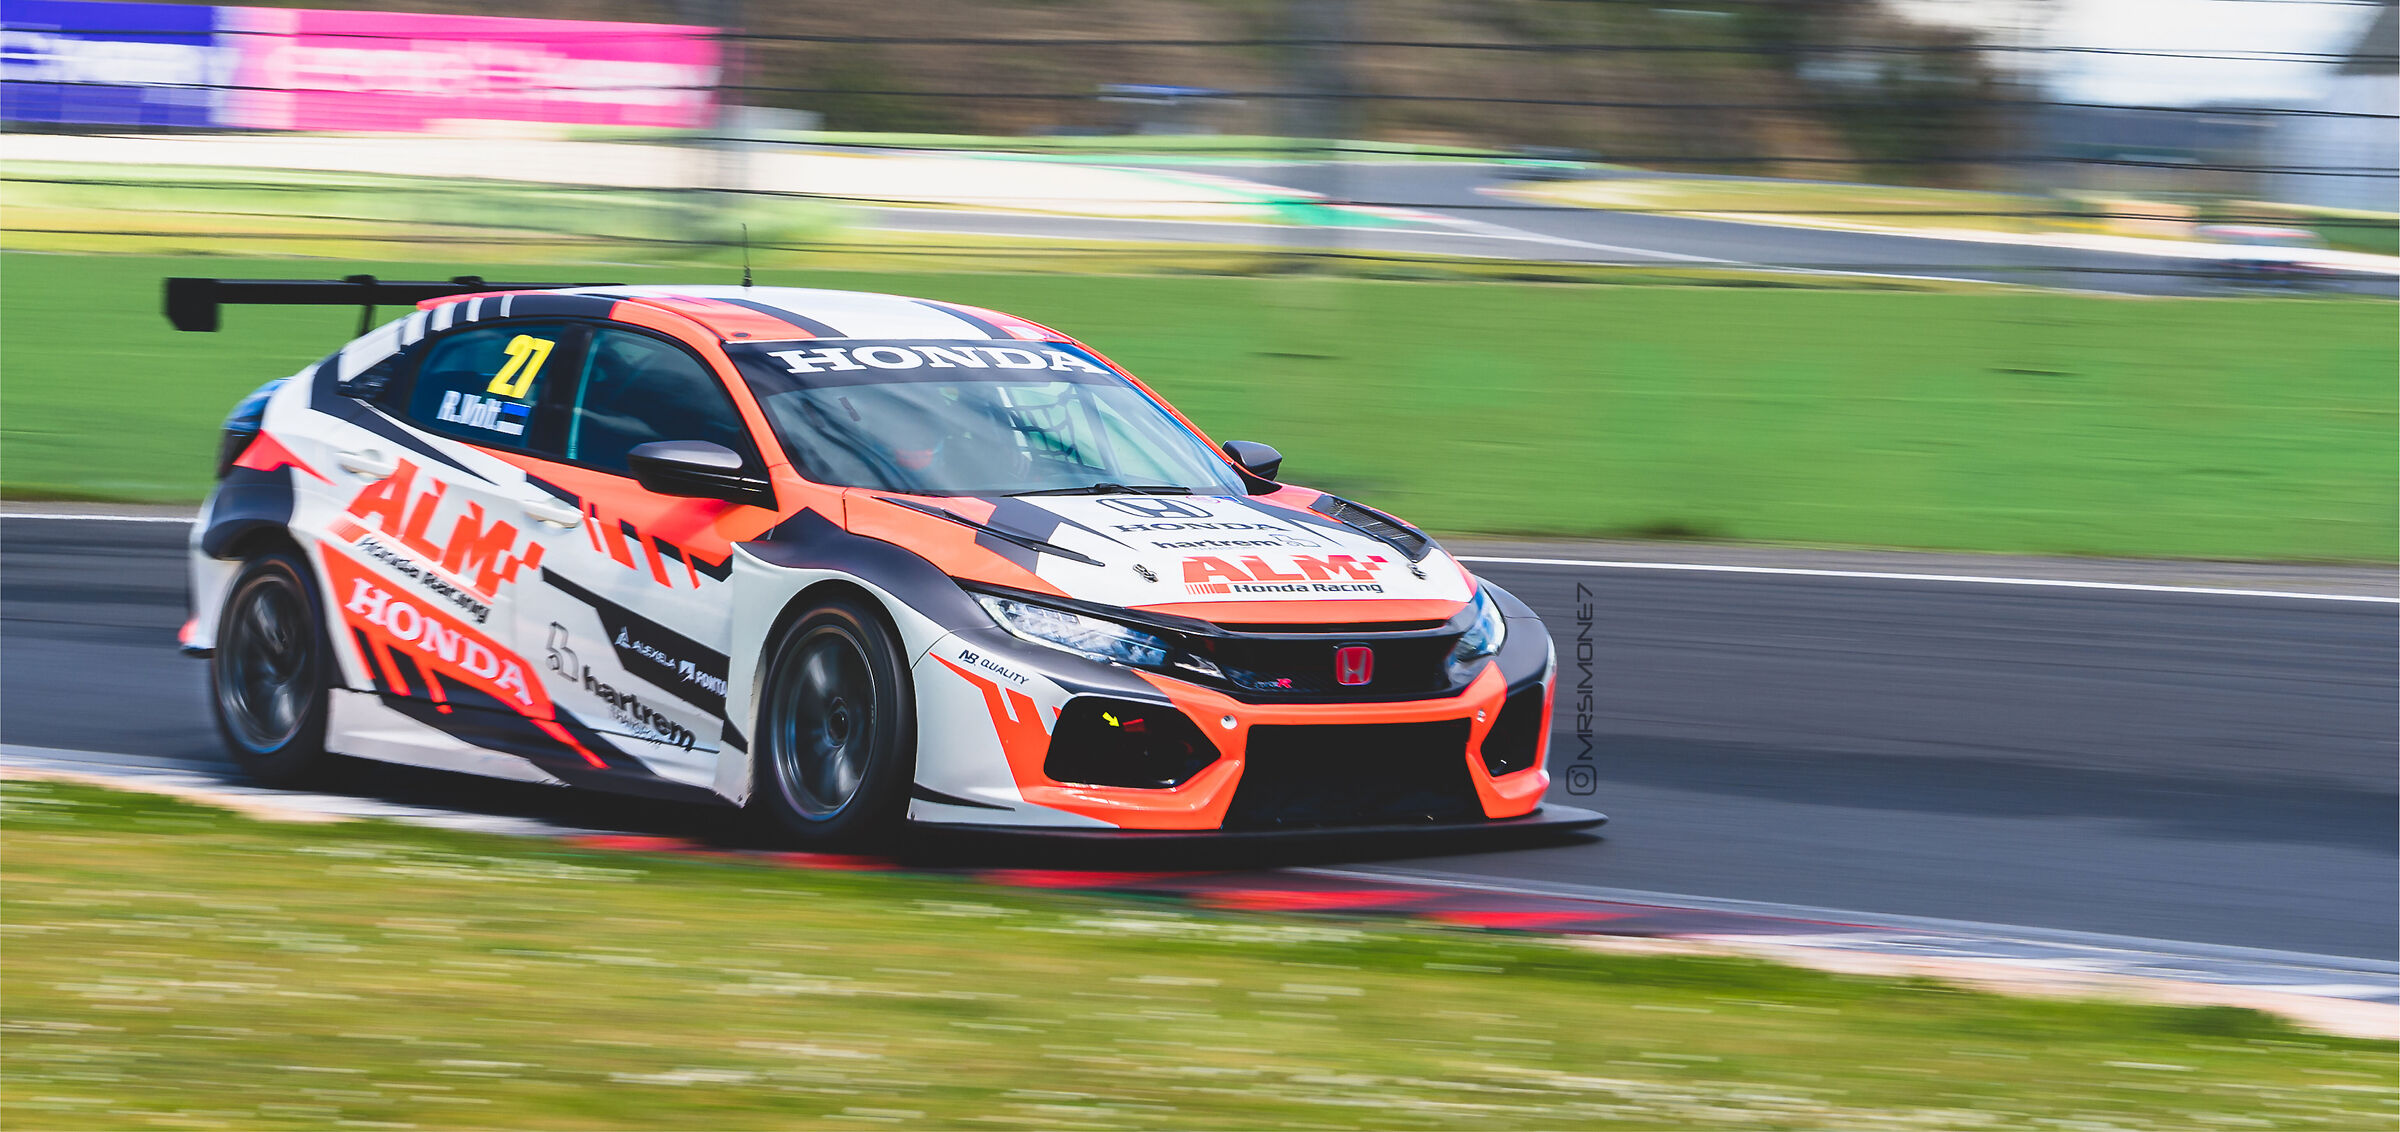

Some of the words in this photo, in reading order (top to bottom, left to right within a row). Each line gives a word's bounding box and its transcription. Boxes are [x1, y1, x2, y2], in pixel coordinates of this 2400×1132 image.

[487, 334, 555, 399] 27
[767, 346, 1111, 374] HONDA
[345, 457, 518, 597] ALM
[1109, 523, 1291, 533] HONDA
[1151, 538, 1284, 549] hartrem
[356, 536, 419, 579] Honda
[421, 572, 491, 624] Racing
[1182, 555, 1375, 582] ALM
[1233, 583, 1310, 593] Honda
[1312, 583, 1385, 594] Racing
[345, 578, 534, 706] HONDA
[980, 658, 1030, 685] QUALITY
[583, 664, 696, 753] hartrem
